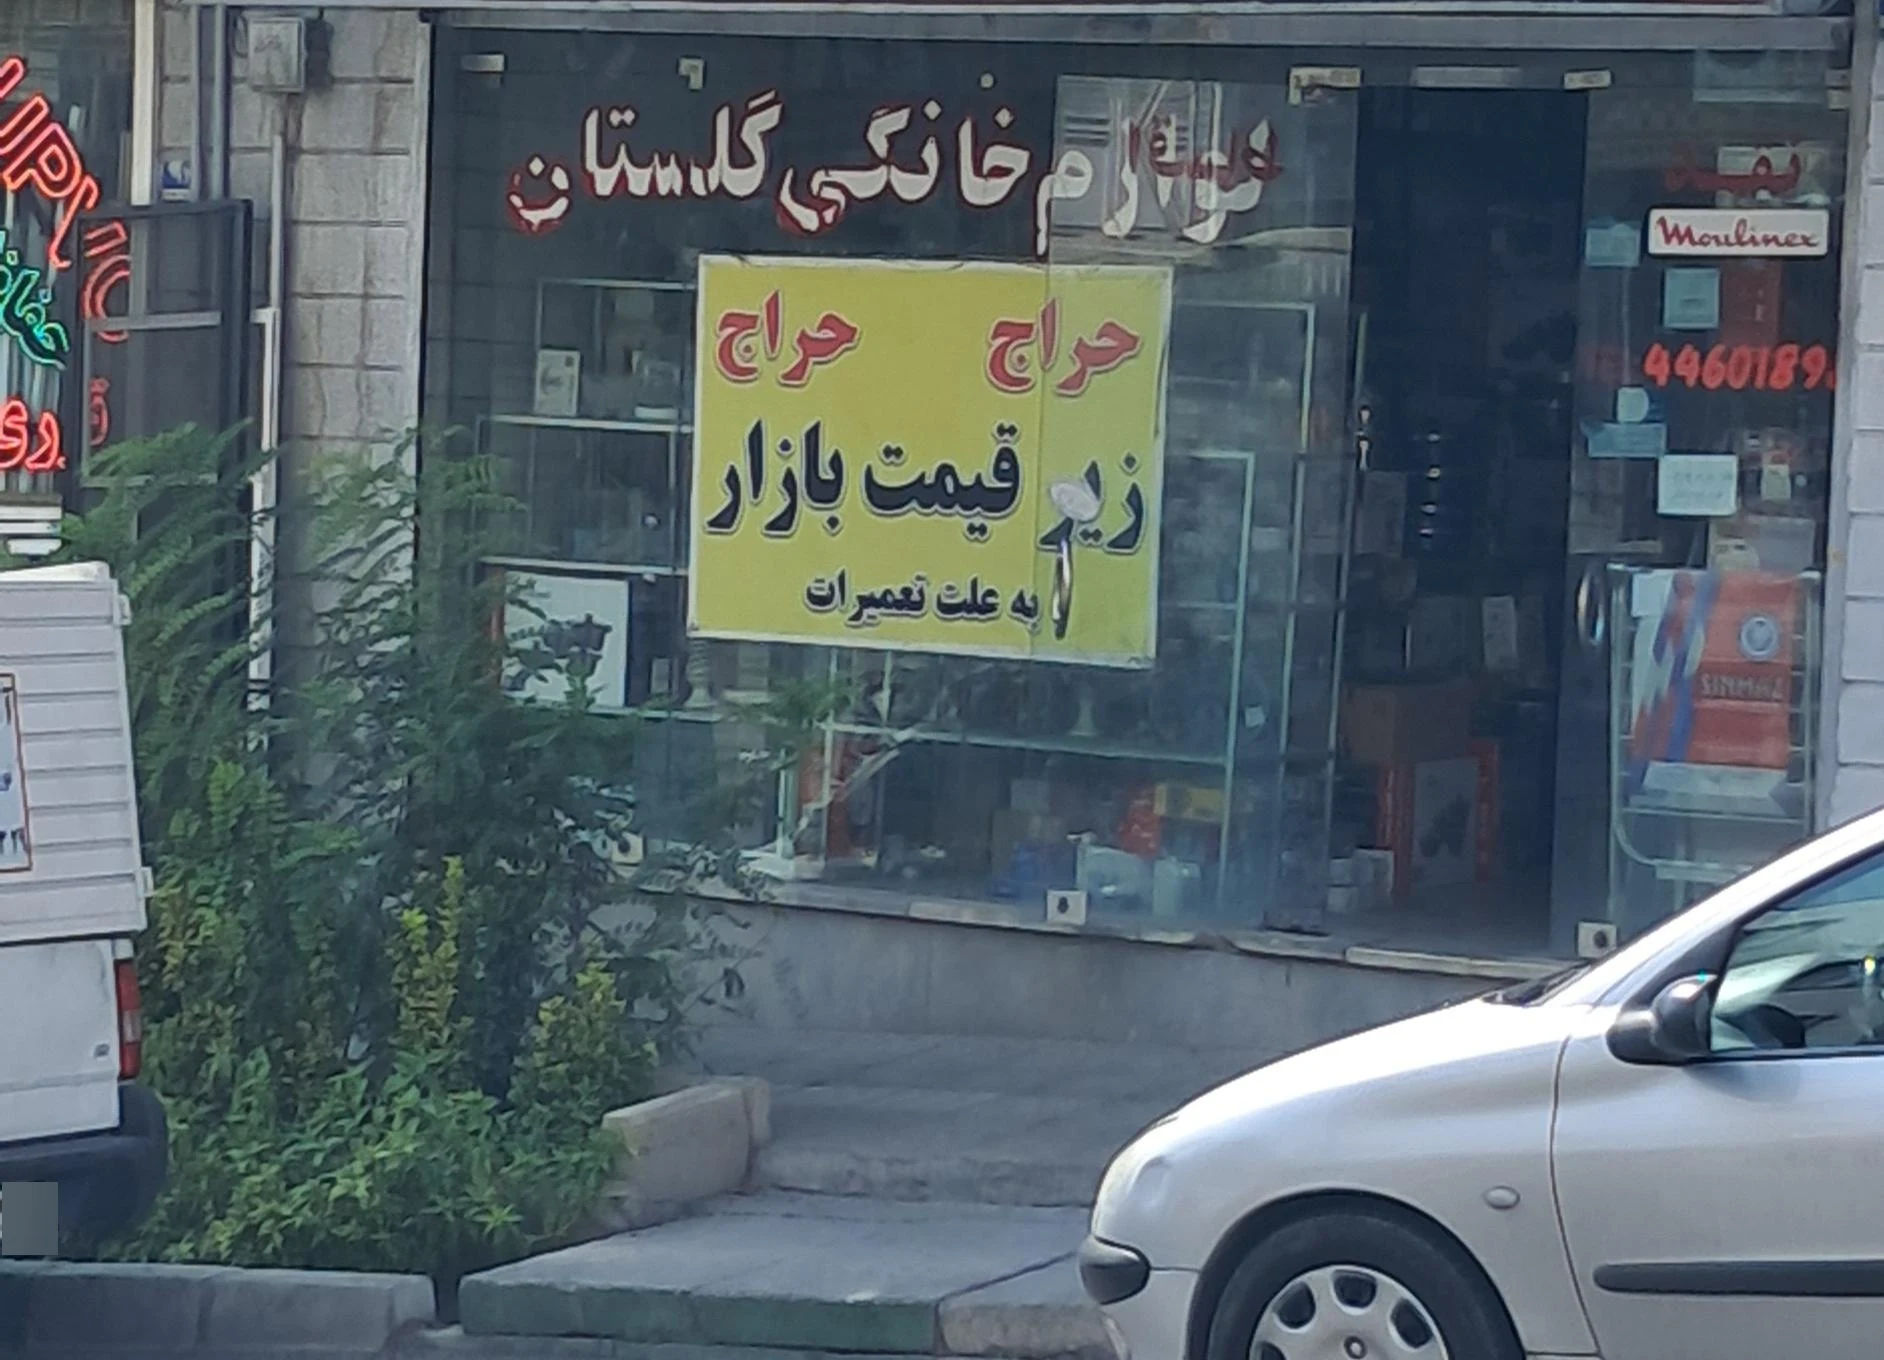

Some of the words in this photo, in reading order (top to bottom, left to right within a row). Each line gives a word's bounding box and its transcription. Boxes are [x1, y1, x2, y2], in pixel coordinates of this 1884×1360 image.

[506, 88, 784, 235] گلستان
[779, 98, 1031, 234] خانگی
[1657, 215, 1821, 249] Moulinex
[714, 290, 860, 388] حراج
[984, 296, 1144, 397] حراج
[1644, 343, 1837, 390] 4460189
[704, 418, 845, 538] بازار
[863, 421, 1022, 543] قیمت
[803, 567, 929, 627] تعمیرات
[934, 576, 1001, 619] علت
[1008, 588, 1041, 633] به
